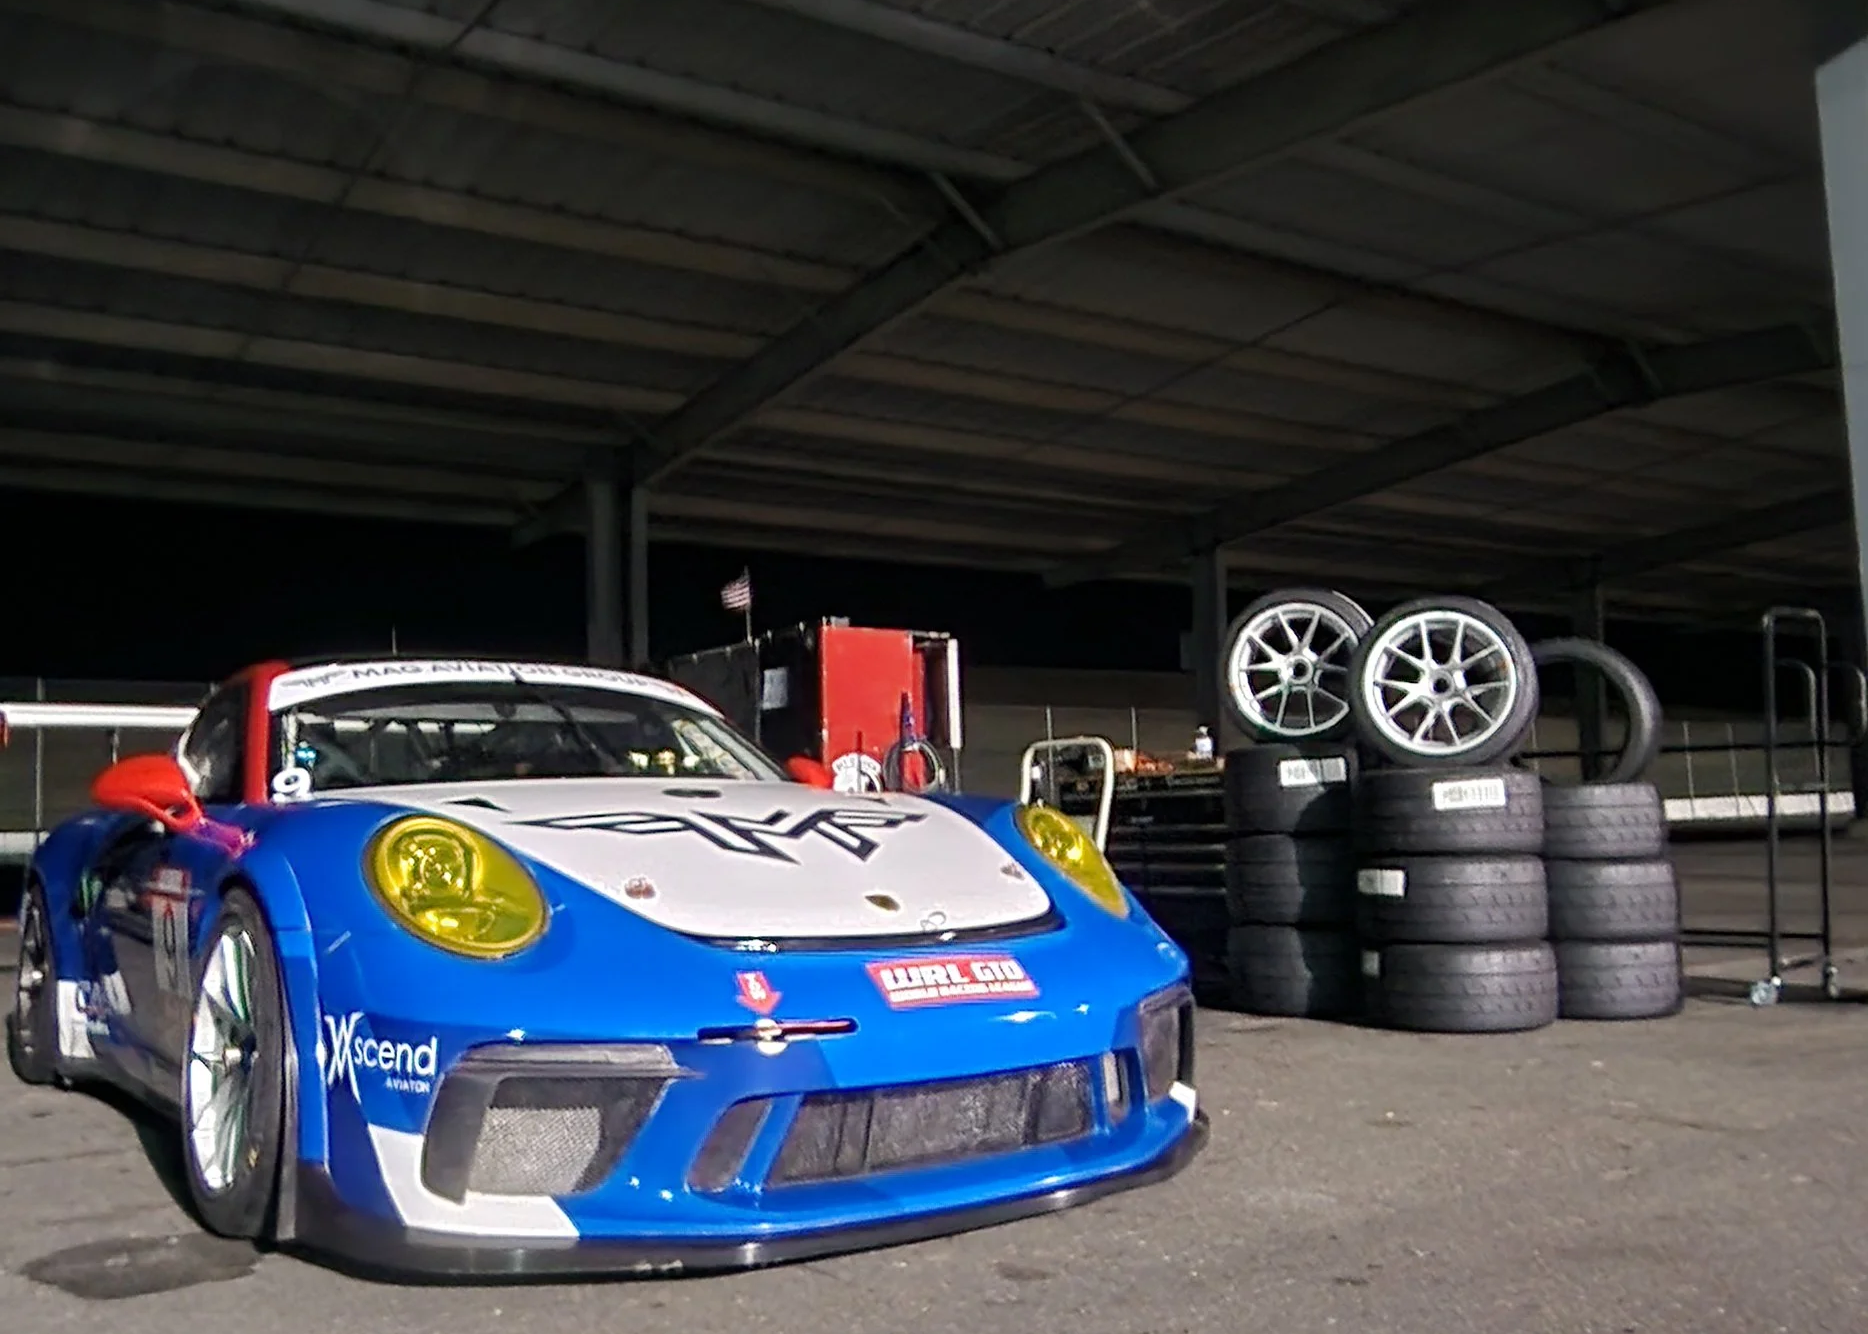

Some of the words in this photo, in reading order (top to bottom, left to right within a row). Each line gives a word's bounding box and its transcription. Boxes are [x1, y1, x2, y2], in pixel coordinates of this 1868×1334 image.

[352, 666, 423, 679] MAG
[272, 767, 312, 802] 9
[879, 964, 970, 991] WRL
